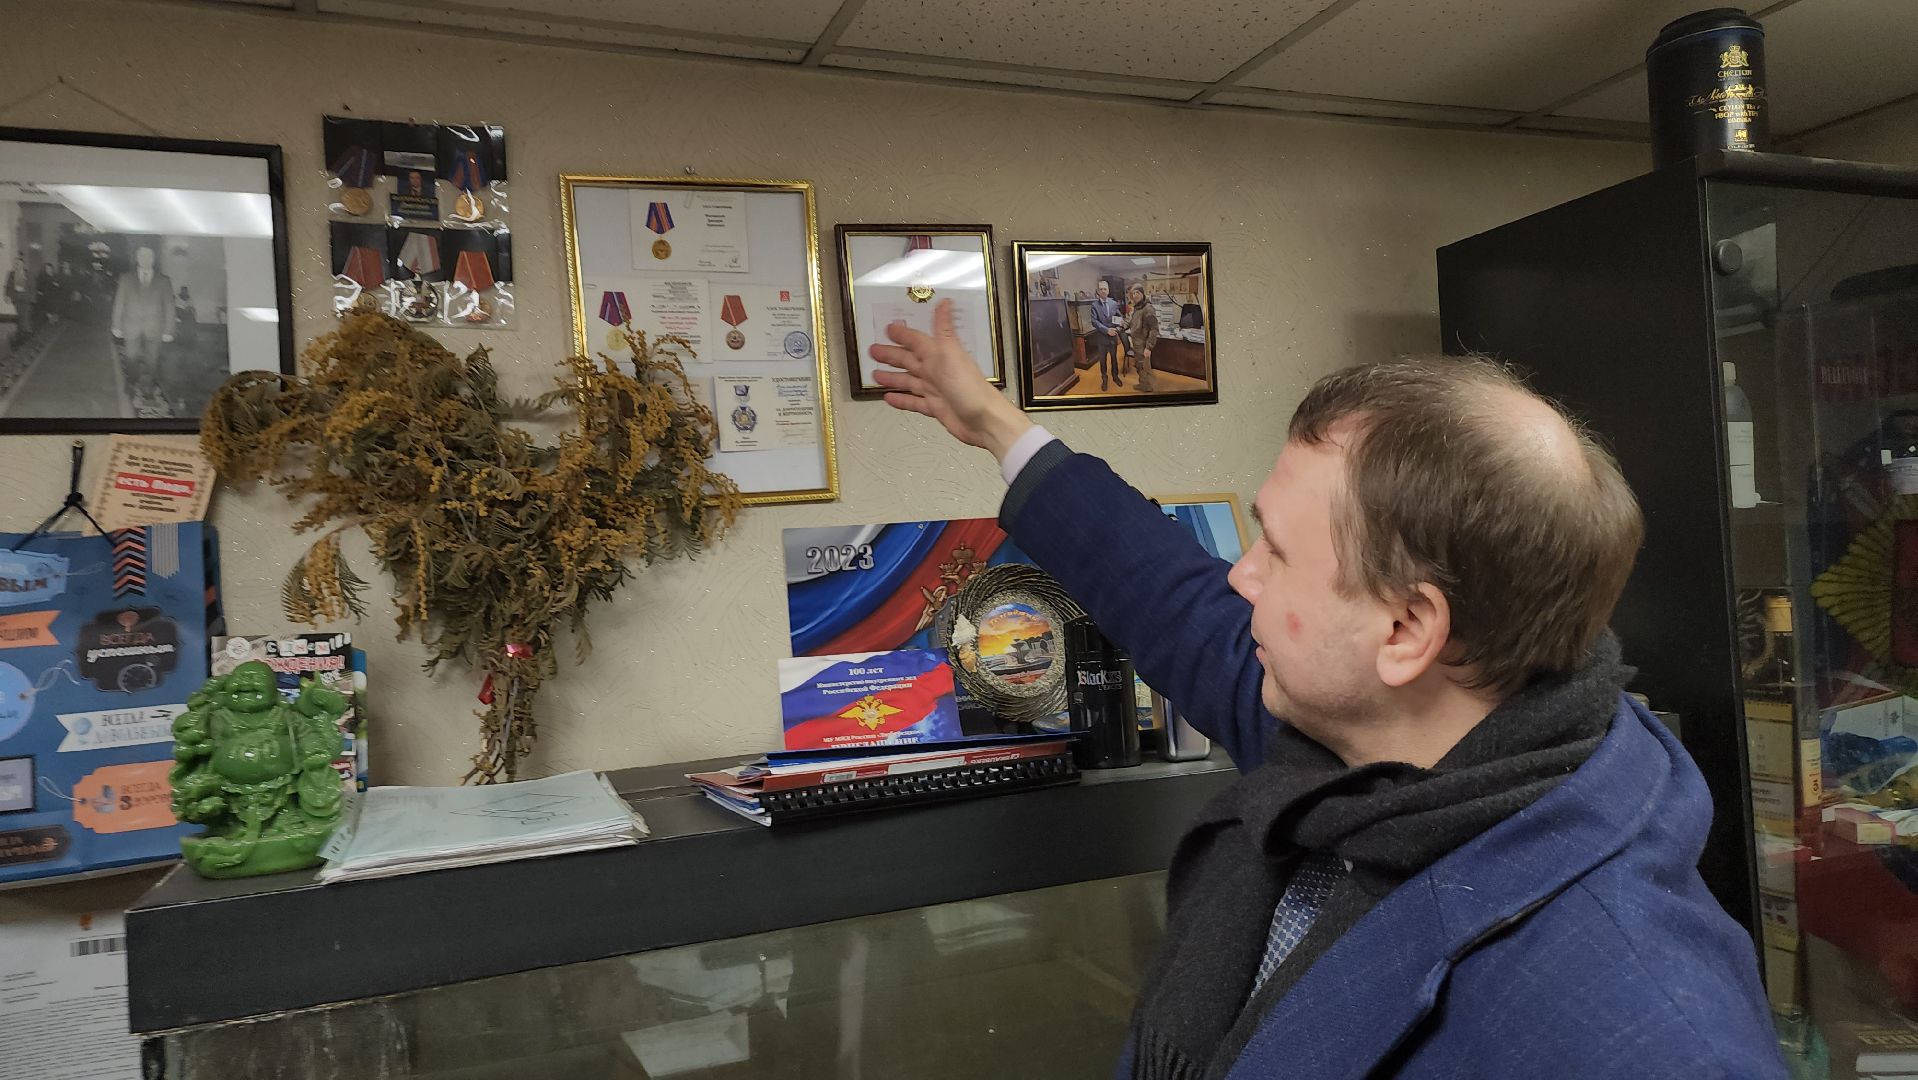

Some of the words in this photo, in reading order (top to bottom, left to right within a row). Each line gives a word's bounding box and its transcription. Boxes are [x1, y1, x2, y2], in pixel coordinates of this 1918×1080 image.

[806, 543, 875, 575] 2023
[848, 667, 866, 676] 100
[866, 667, 885, 675] лет
[831, 737, 920, 749] ПРИГЛАШНИЕ
